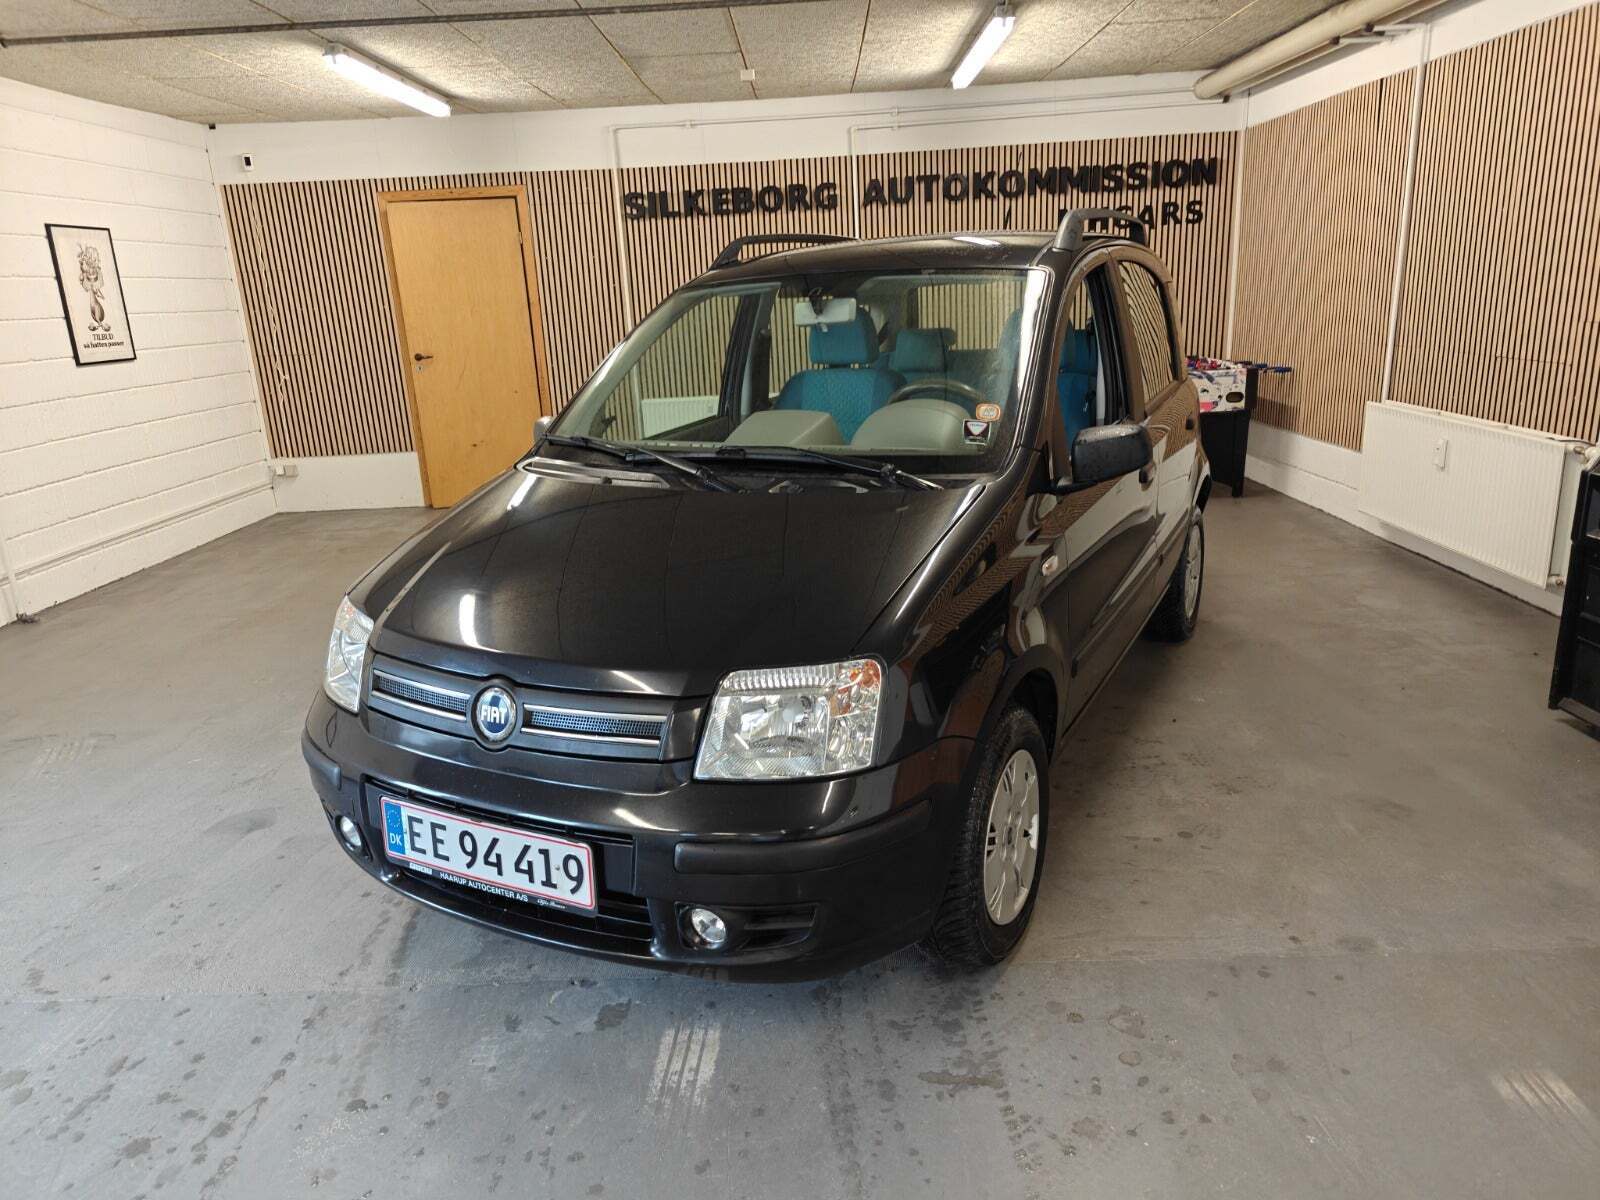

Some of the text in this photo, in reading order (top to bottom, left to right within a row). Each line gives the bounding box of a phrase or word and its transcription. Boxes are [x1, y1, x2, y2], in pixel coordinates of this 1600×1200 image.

[623, 157, 1217, 220] SILKEBORG AUTOKOMMISSION
[92, 333, 114, 341] TILBUD
[481, 704, 507, 724] FIAT
[389, 832, 402, 846] DK
[407, 815, 585, 895] EE 94 419
[440, 872, 529, 903] HAARUP AUTOCENTER A/S
